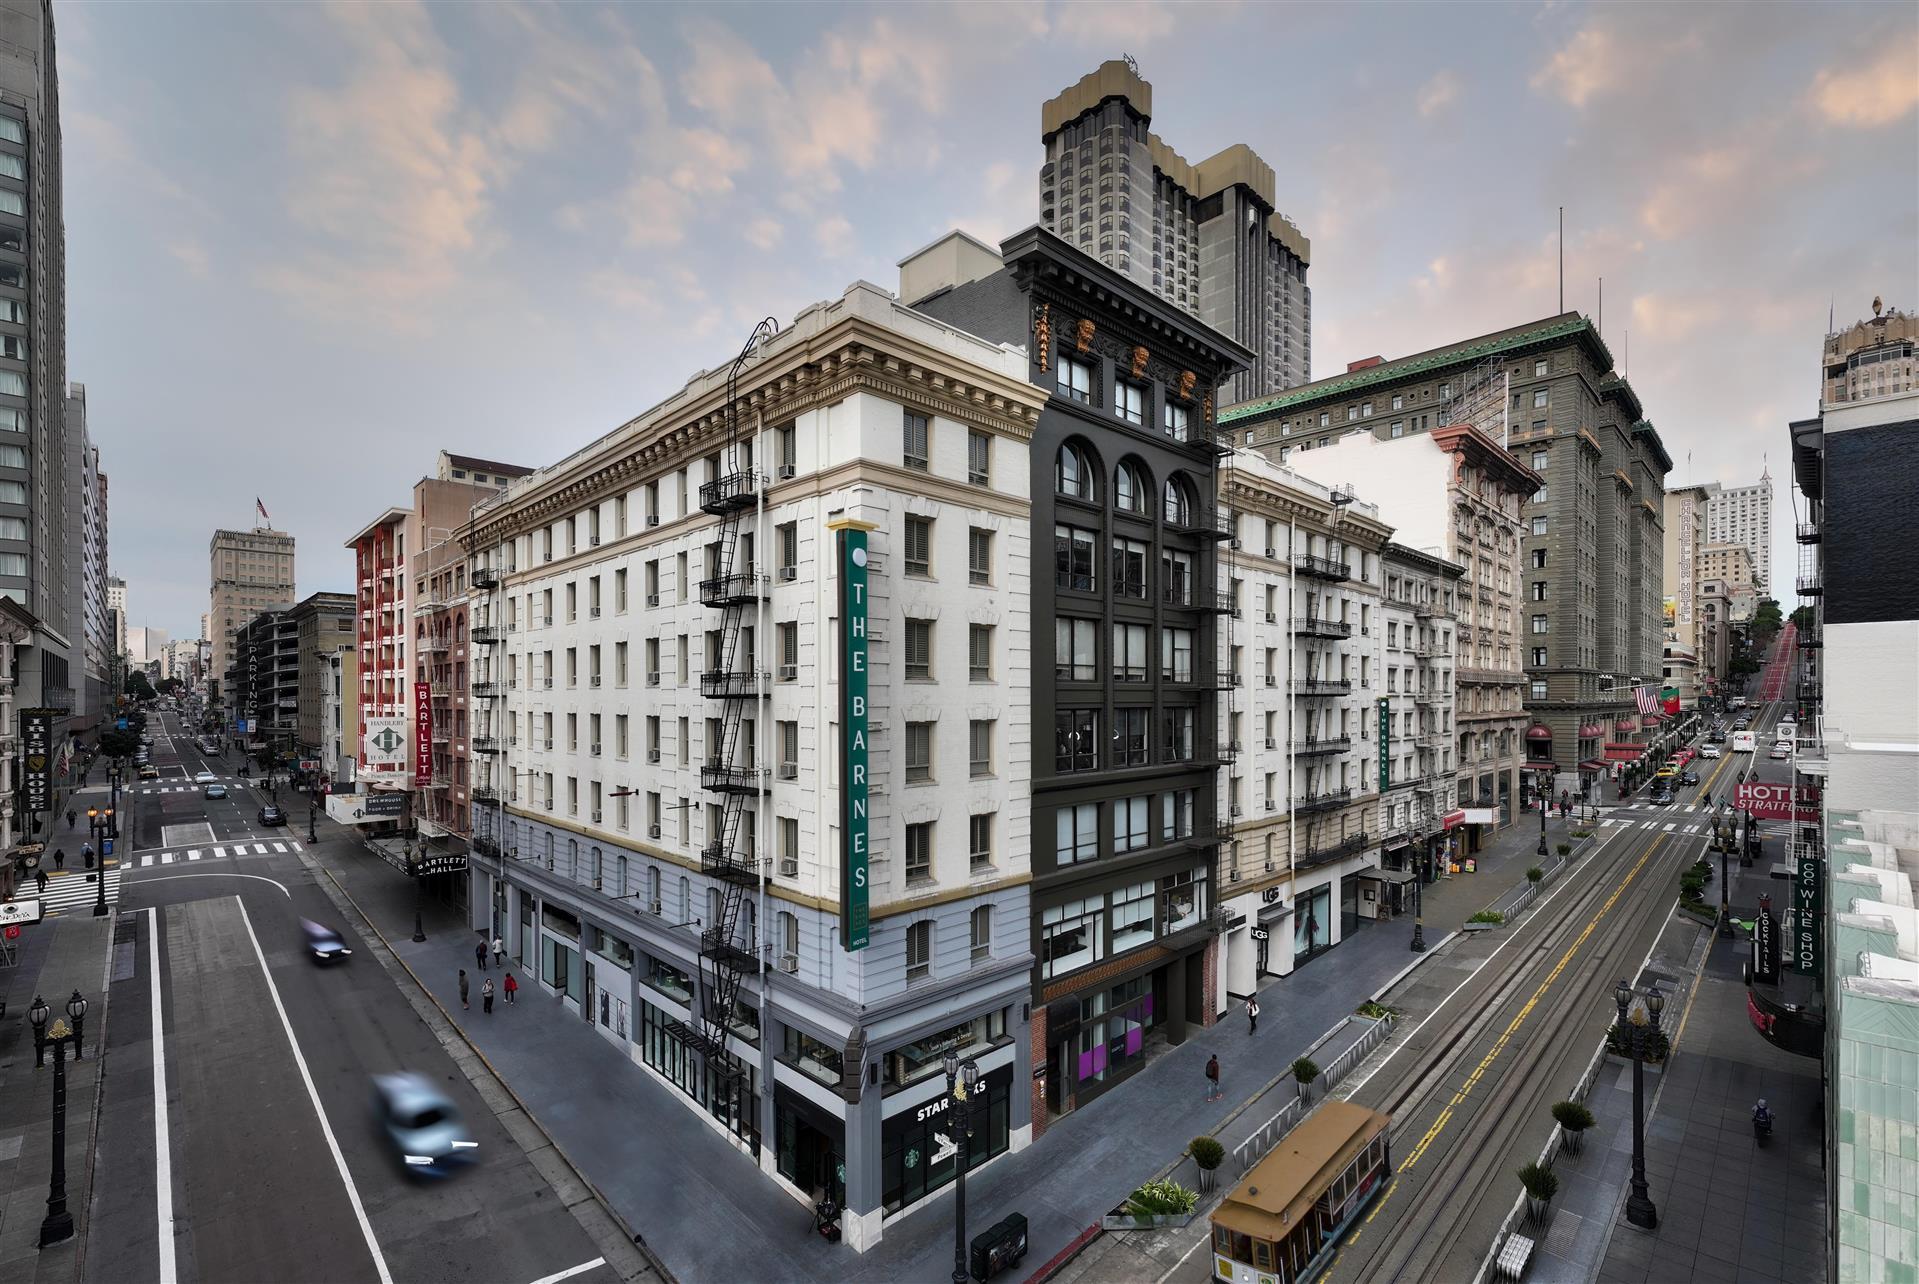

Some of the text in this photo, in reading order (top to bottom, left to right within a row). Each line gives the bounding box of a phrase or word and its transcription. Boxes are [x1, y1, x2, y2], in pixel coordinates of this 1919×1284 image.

[1681, 499, 1691, 622] CHANCELLOR HOTEL
[249, 646, 258, 709] PARKING
[25, 718, 46, 755] IRISH
[419, 691, 429, 774] BARTLETT
[853, 583, 866, 887] THE BARNES
[25, 772, 46, 809] HOUSE
[430, 865, 453, 874] HALL
[1251, 929, 1268, 939] UGG
[1800, 932, 1814, 970] SHOP
